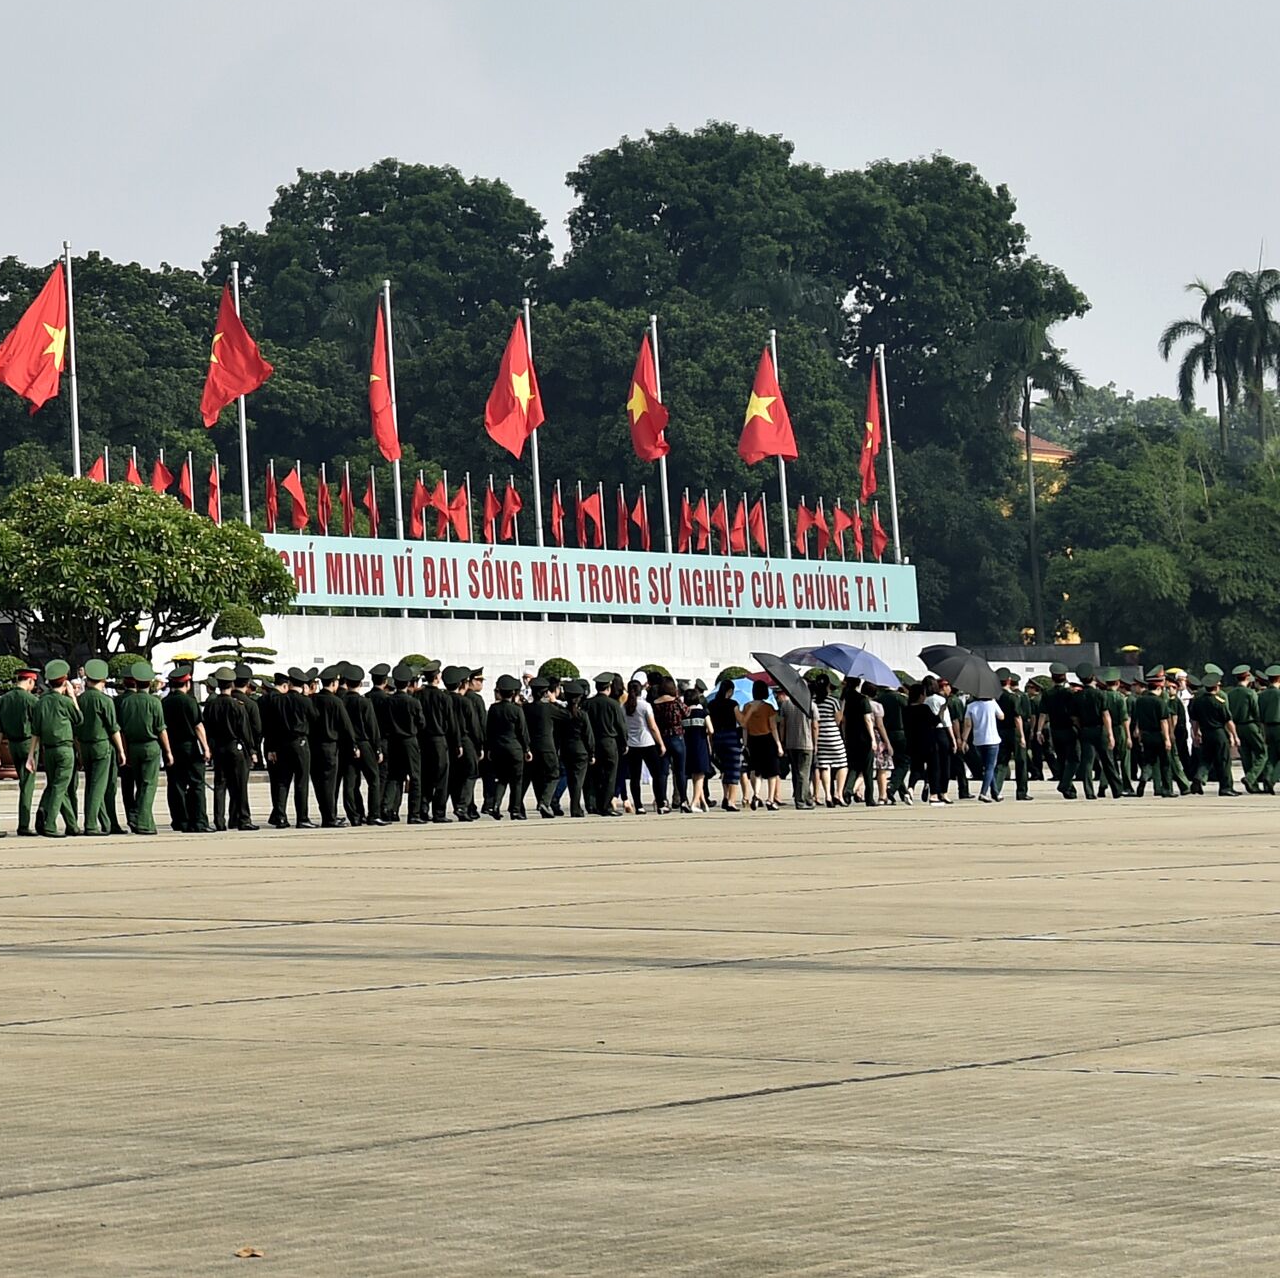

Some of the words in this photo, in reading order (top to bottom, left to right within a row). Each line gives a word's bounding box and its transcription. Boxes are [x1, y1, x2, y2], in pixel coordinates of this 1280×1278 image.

[326, 552, 384, 596] MINH
[393, 547, 414, 597] VĨ
[423, 556, 459, 606] ĐẠI
[467, 547, 523, 600] SỐNG
[530, 554, 570, 602] MÃI
[576, 563, 640, 605] TRONG
[648, 562, 672, 613] SỰ
[679, 562, 744, 615] NGHIỆP
[751, 560, 787, 609] CỦA
[793, 566, 849, 611] CHÚNG
[855, 576, 877, 612] TA
[882, 577, 889, 613] !
